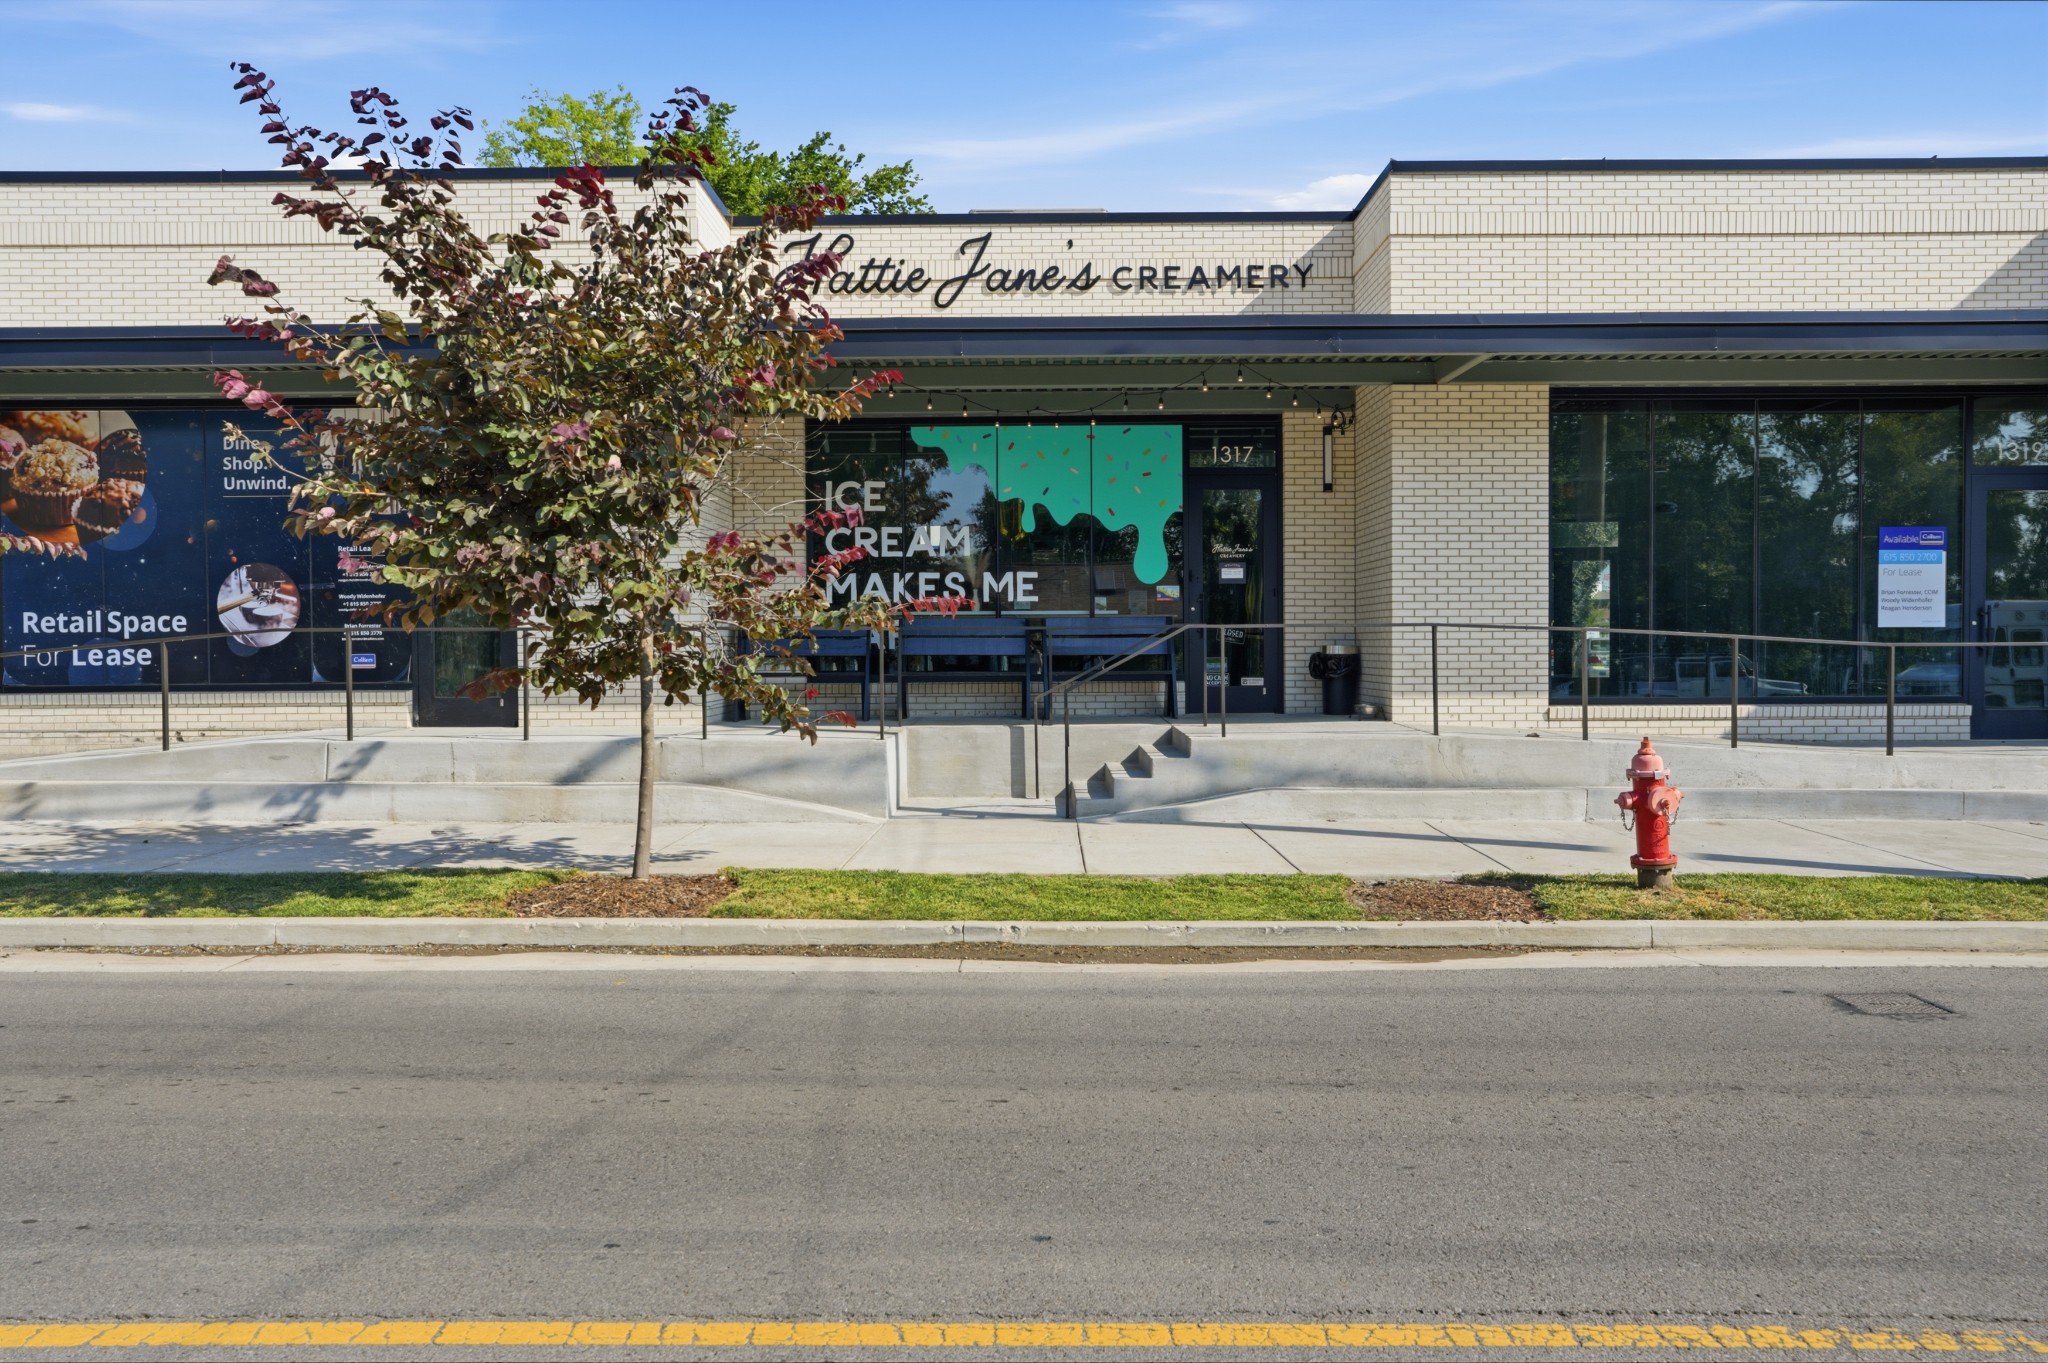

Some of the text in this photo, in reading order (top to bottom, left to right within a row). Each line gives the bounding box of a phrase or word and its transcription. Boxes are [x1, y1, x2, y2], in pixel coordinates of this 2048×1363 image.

[774, 231, 1314, 308] Hattie Jane's CREAMERY
[1211, 446, 1254, 463] 1317
[1998, 442, 2043, 460] 1319
[223, 456, 268, 474] Shop.
[223, 475, 292, 490] Unwind.
[825, 480, 886, 512] ICE
[825, 526, 971, 558] CREAM
[1883, 535, 1919, 544] Available
[1883, 552, 1898, 560] 615
[1917, 552, 1937, 560] 2700
[1882, 568, 1922, 576] For Lease
[825, 571, 1039, 604] MAKES ME
[22, 610, 187, 640] Retail Space
[1224, 629, 1244, 638] LOSED
[23, 644, 152, 666] For Lease
